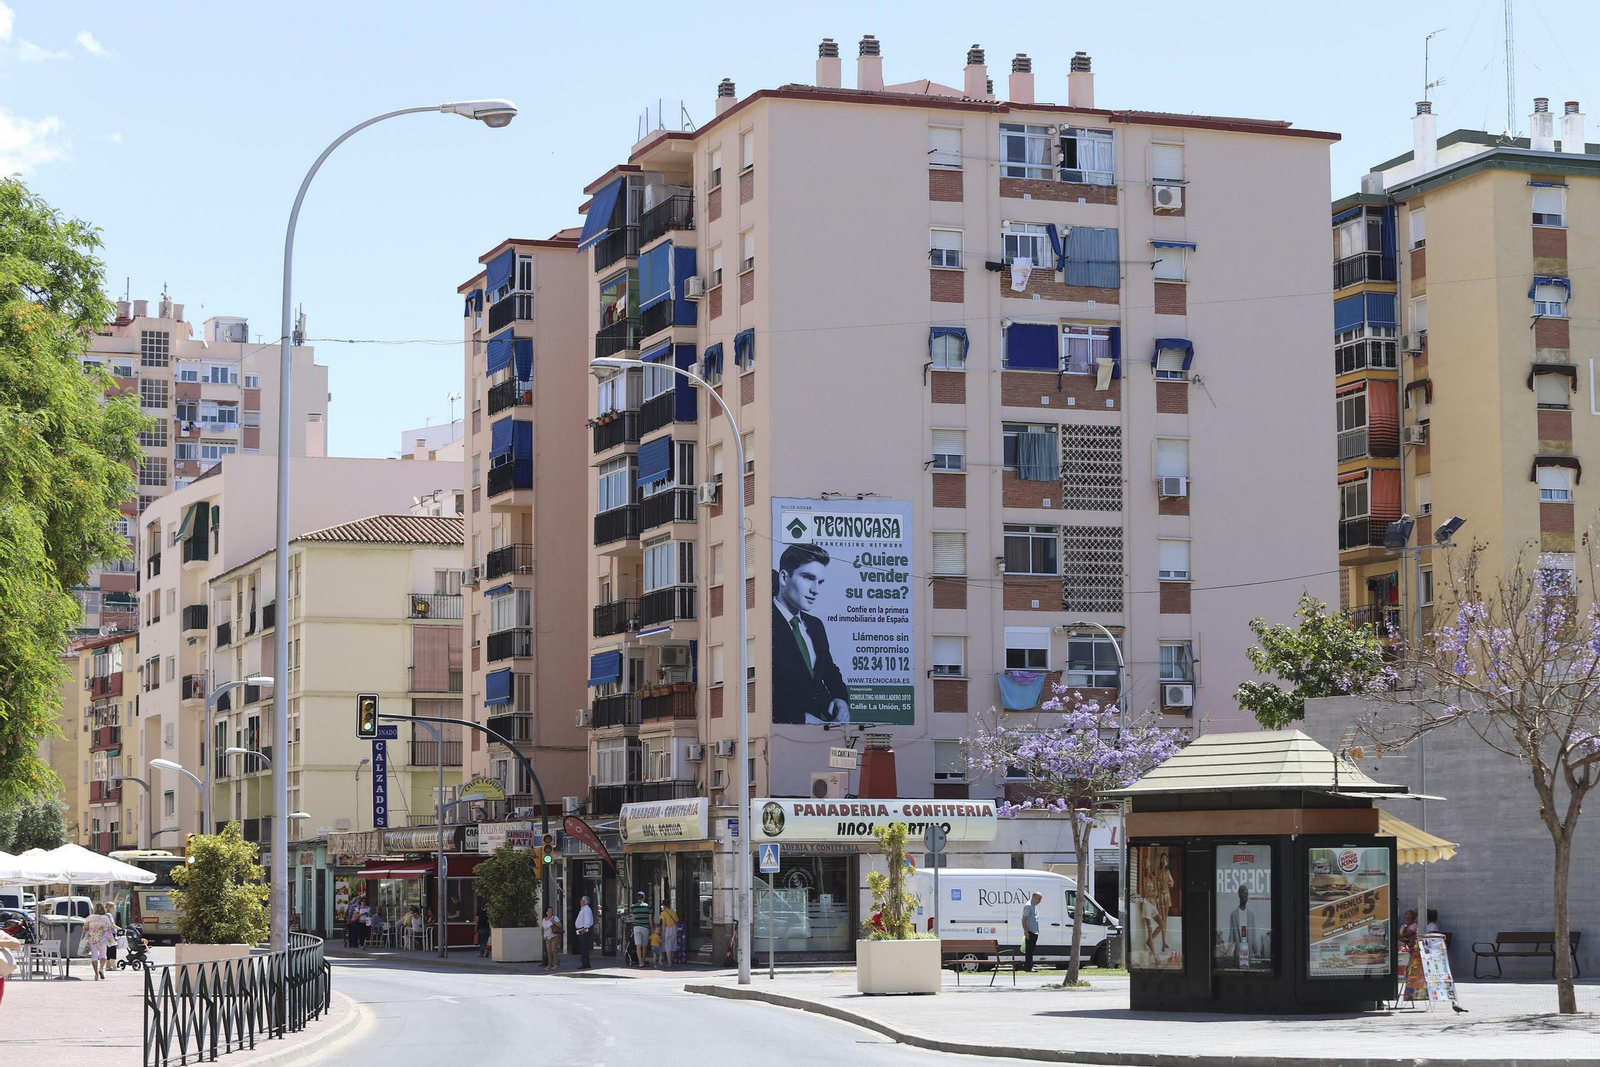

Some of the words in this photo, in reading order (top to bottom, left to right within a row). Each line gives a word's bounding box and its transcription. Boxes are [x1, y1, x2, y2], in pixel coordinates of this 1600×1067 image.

[813, 515, 901, 539] TECNOCASA
[853, 551, 909, 569] ¿Quiere
[859, 568, 910, 583] vender
[845, 588, 863, 599] su
[866, 585, 909, 600] casa?
[877, 605, 884, 614] la
[885, 605, 909, 615] primera
[827, 614, 838, 622] red
[838, 614, 876, 623] inmobiliaria
[877, 615, 886, 623] de
[886, 615, 909, 625] España
[852, 632, 894, 642] Llámenos
[896, 632, 909, 642] sin
[855, 644, 910, 655] compromiso
[852, 655, 870, 671] 952
[871, 656, 883, 671] 34
[885, 656, 896, 671] 10
[898, 656, 910, 672] 12
[850, 702, 868, 710] Calle
[878, 703, 901, 711] Unión,
[375, 742, 385, 826] CALZADOS
[629, 805, 661, 820] PANADERIA
[664, 802, 699, 818] CONFITERIA
[793, 803, 890, 817] PANADERIA
[902, 803, 993, 818] CONFITERIA
[507, 838, 532, 847] MATI
[780, 843, 809, 852] ADERIA
[816, 843, 860, 852] CONFITERIA
[1340, 852, 1357, 862] BURGER
[1340, 857, 1359, 868] KING
[1321, 905, 1336, 929] 2
[1339, 906, 1360, 922] BACON
